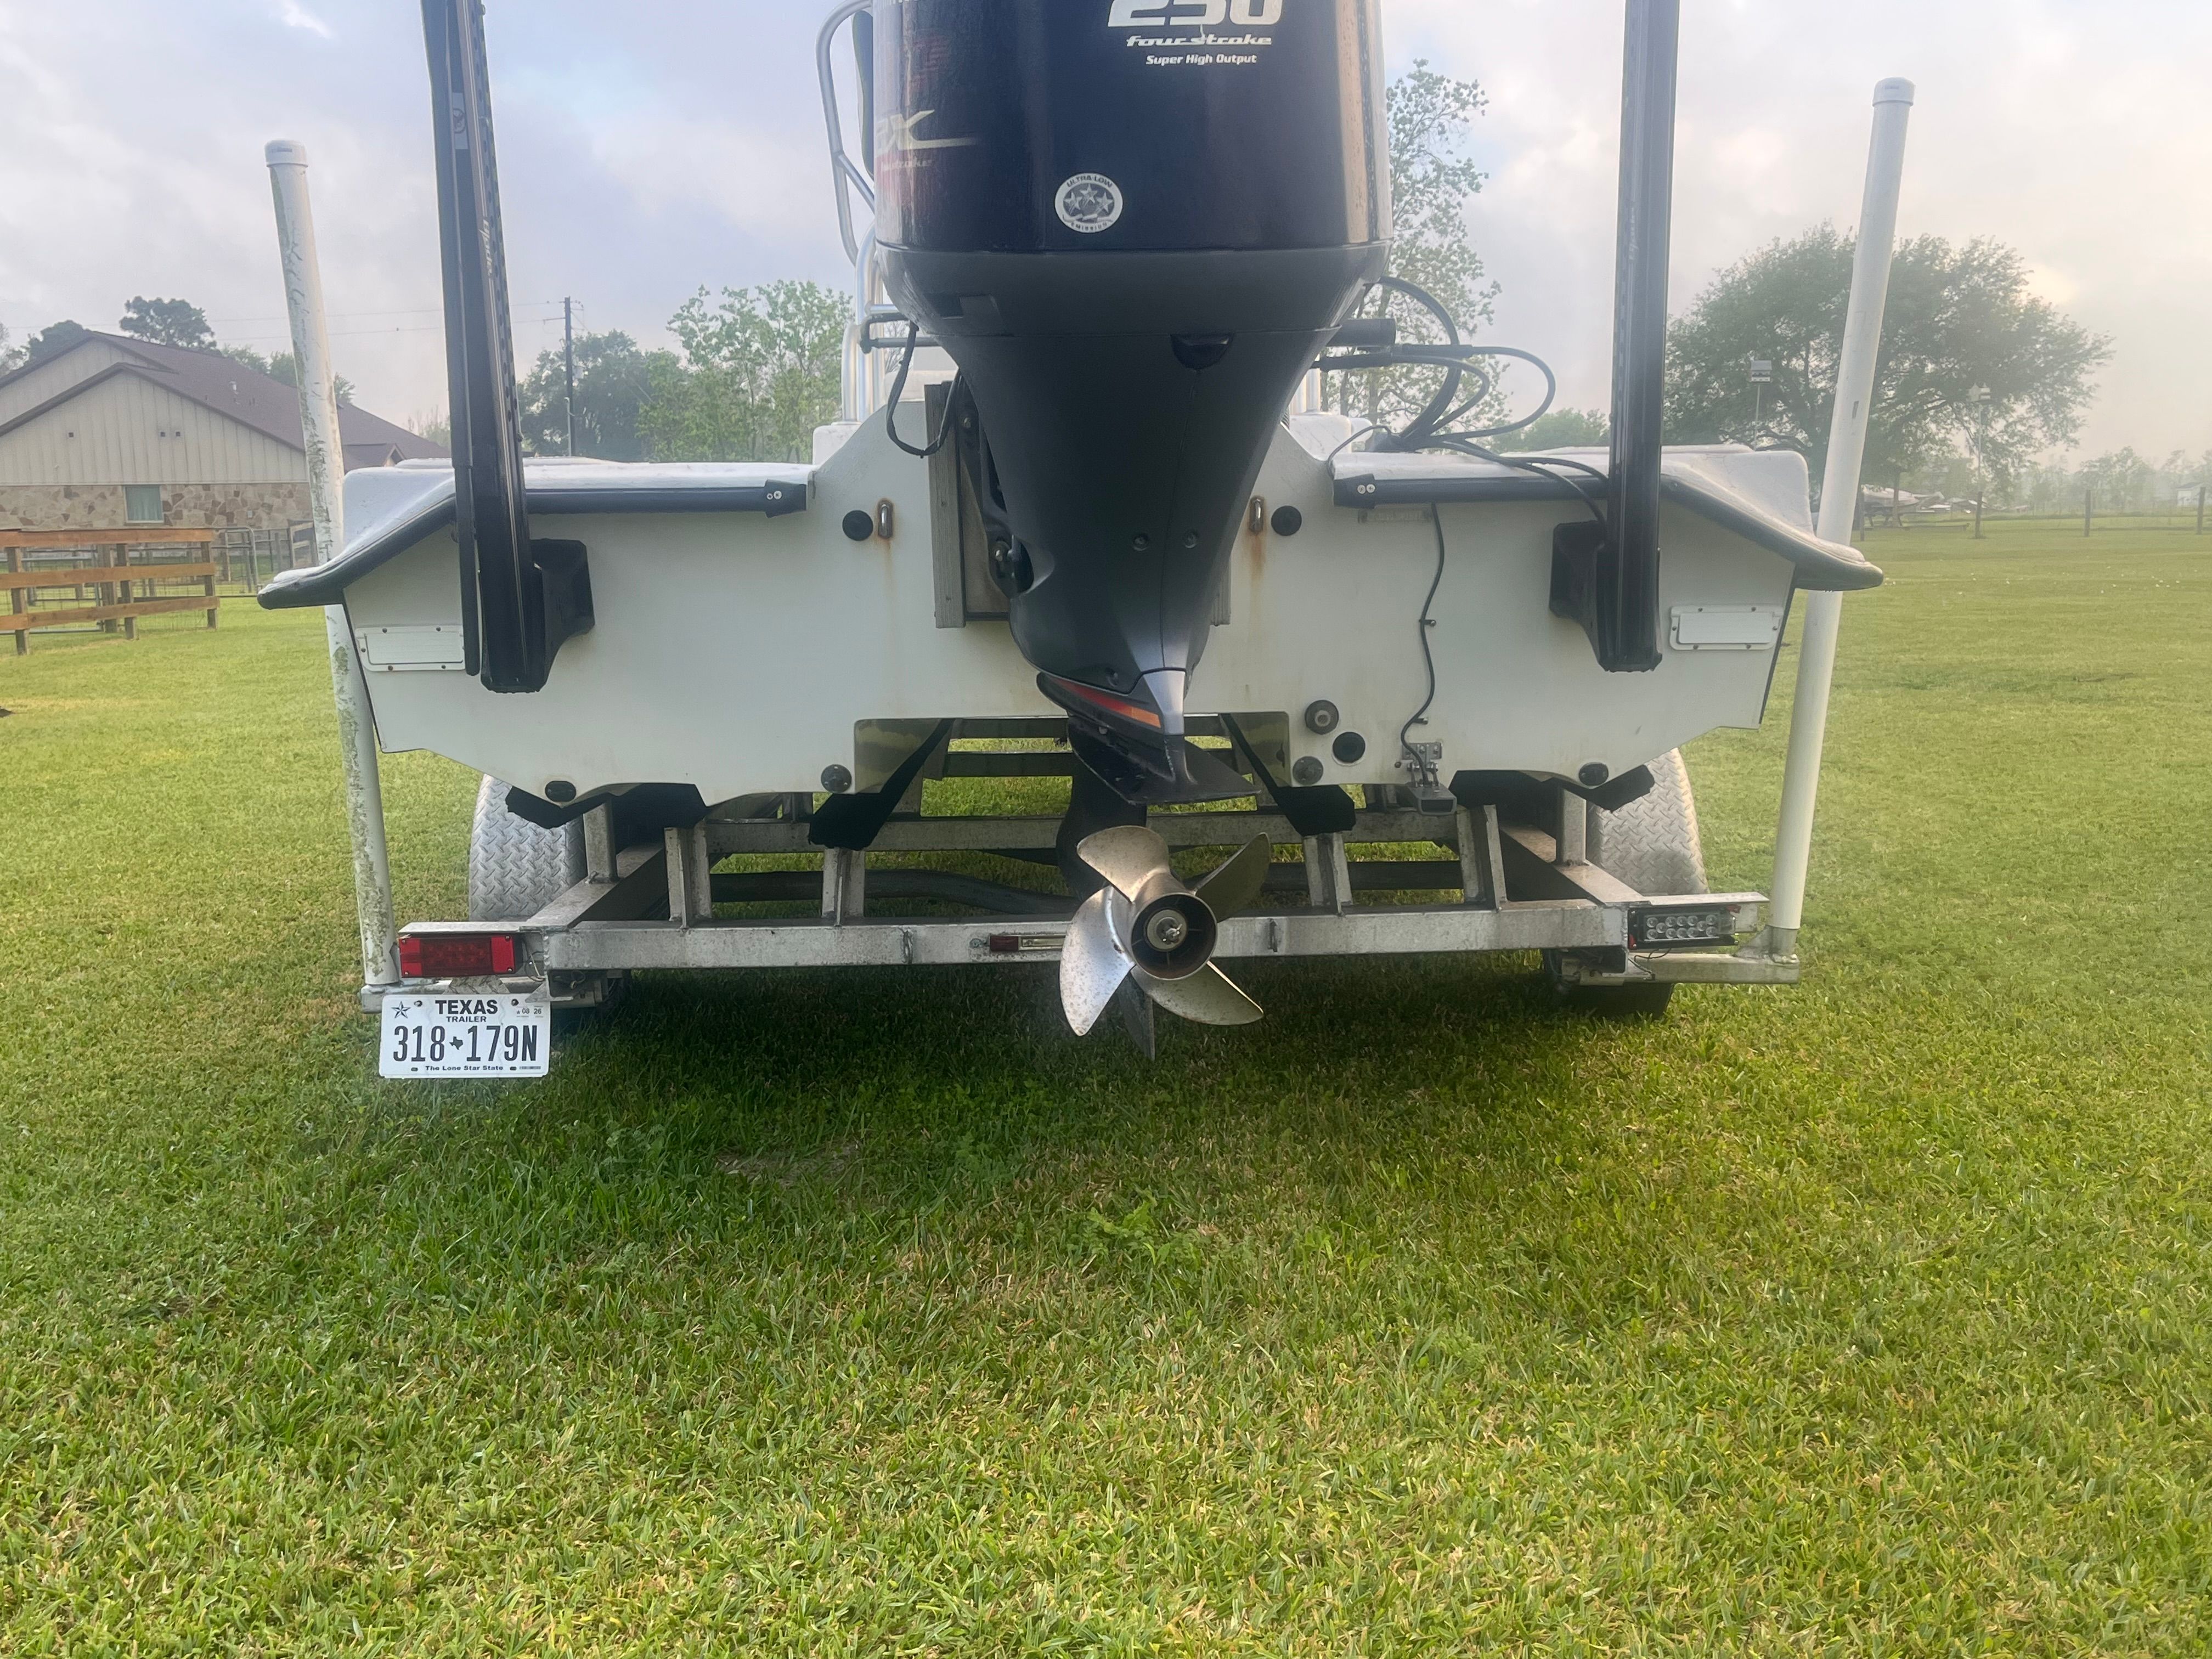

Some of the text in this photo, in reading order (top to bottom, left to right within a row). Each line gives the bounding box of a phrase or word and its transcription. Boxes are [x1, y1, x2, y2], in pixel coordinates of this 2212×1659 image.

[1146, 54, 1257, 66] Super High Output
[1066, 175, 1113, 188] ULTRA LOW
[435, 1000, 498, 1014] TEXAS
[393, 1025, 538, 1062] 318 179N
